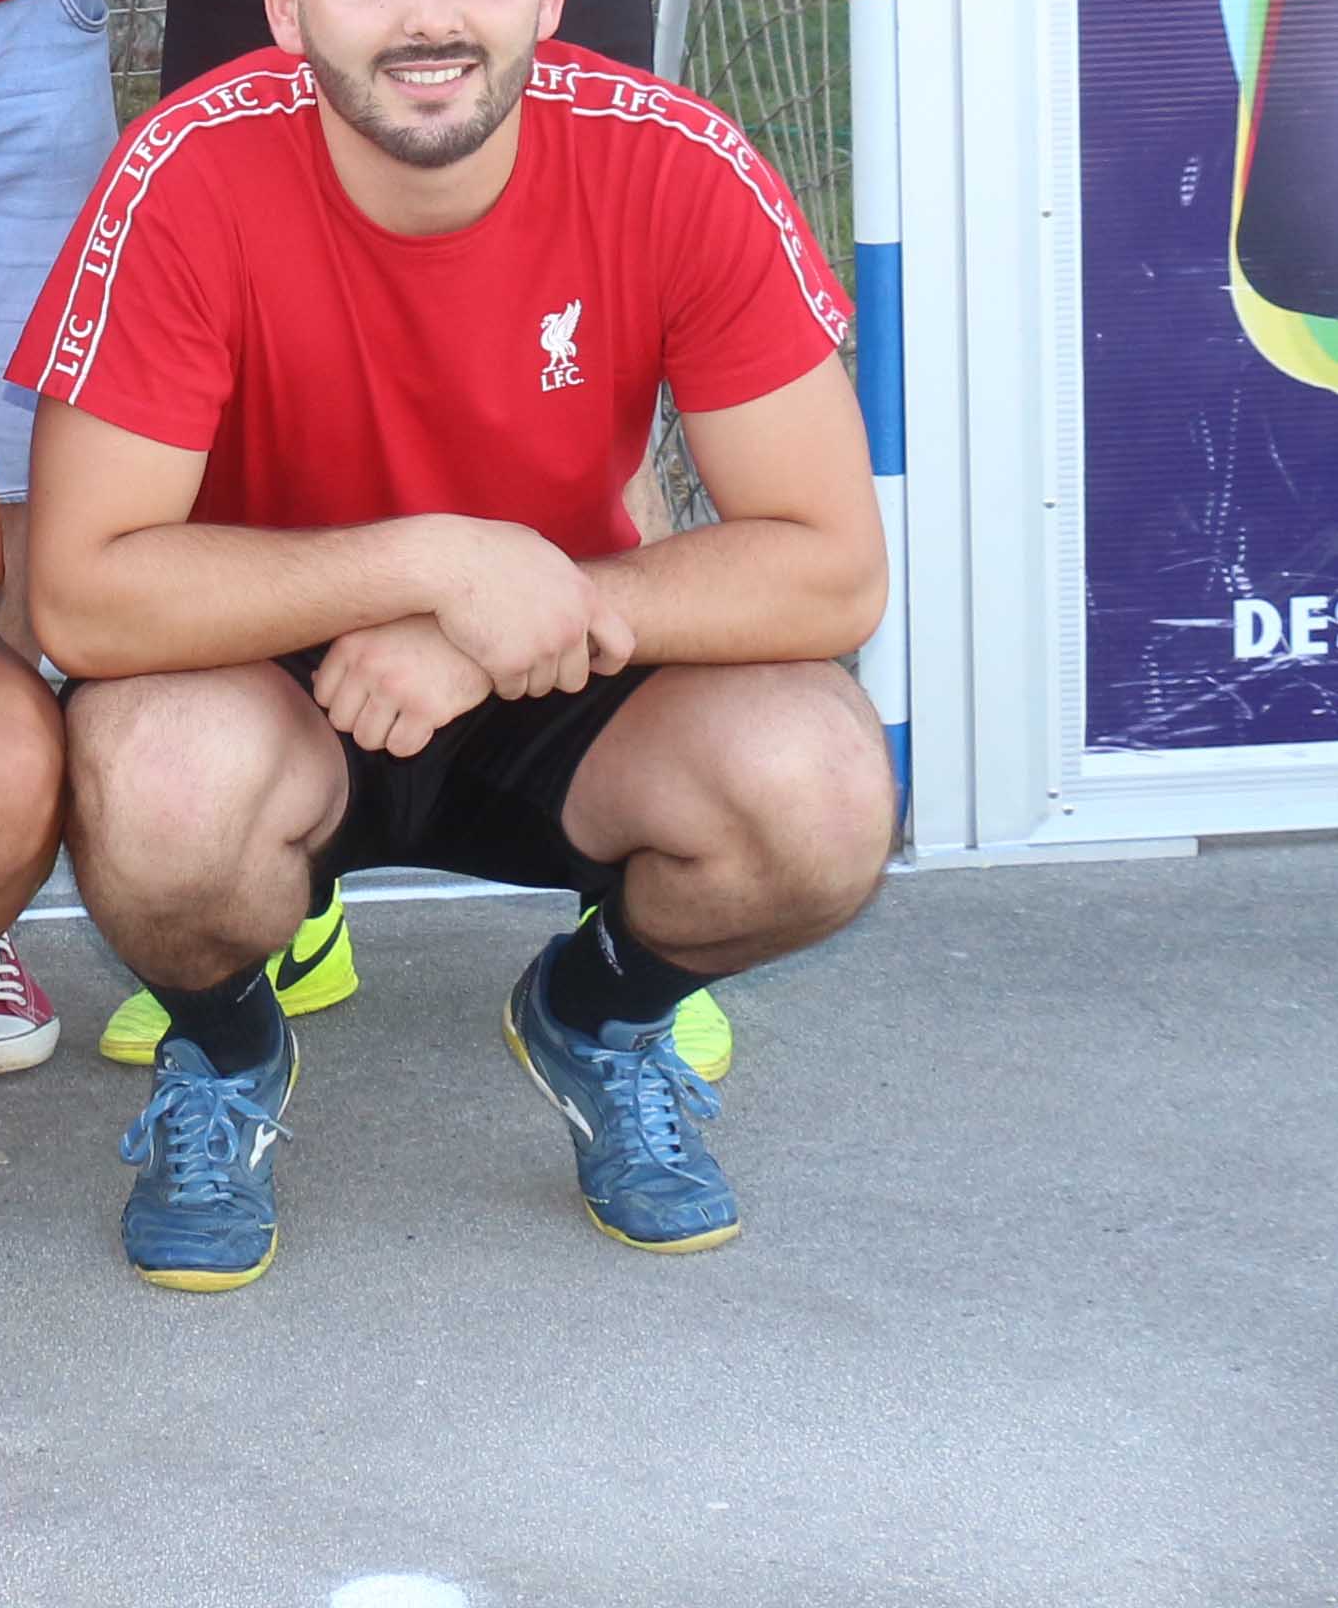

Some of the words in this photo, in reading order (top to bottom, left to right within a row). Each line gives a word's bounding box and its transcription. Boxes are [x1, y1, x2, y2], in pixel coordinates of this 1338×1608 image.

[612, 83, 670, 113] LFC
[704, 119, 755, 171] LFC
[55, 314, 93, 377] LFC
[85, 214, 120, 278] LFC
[124, 122, 173, 181] LFC
[198, 82, 259, 116] LFC
[1233, 595, 1338, 659] DE
